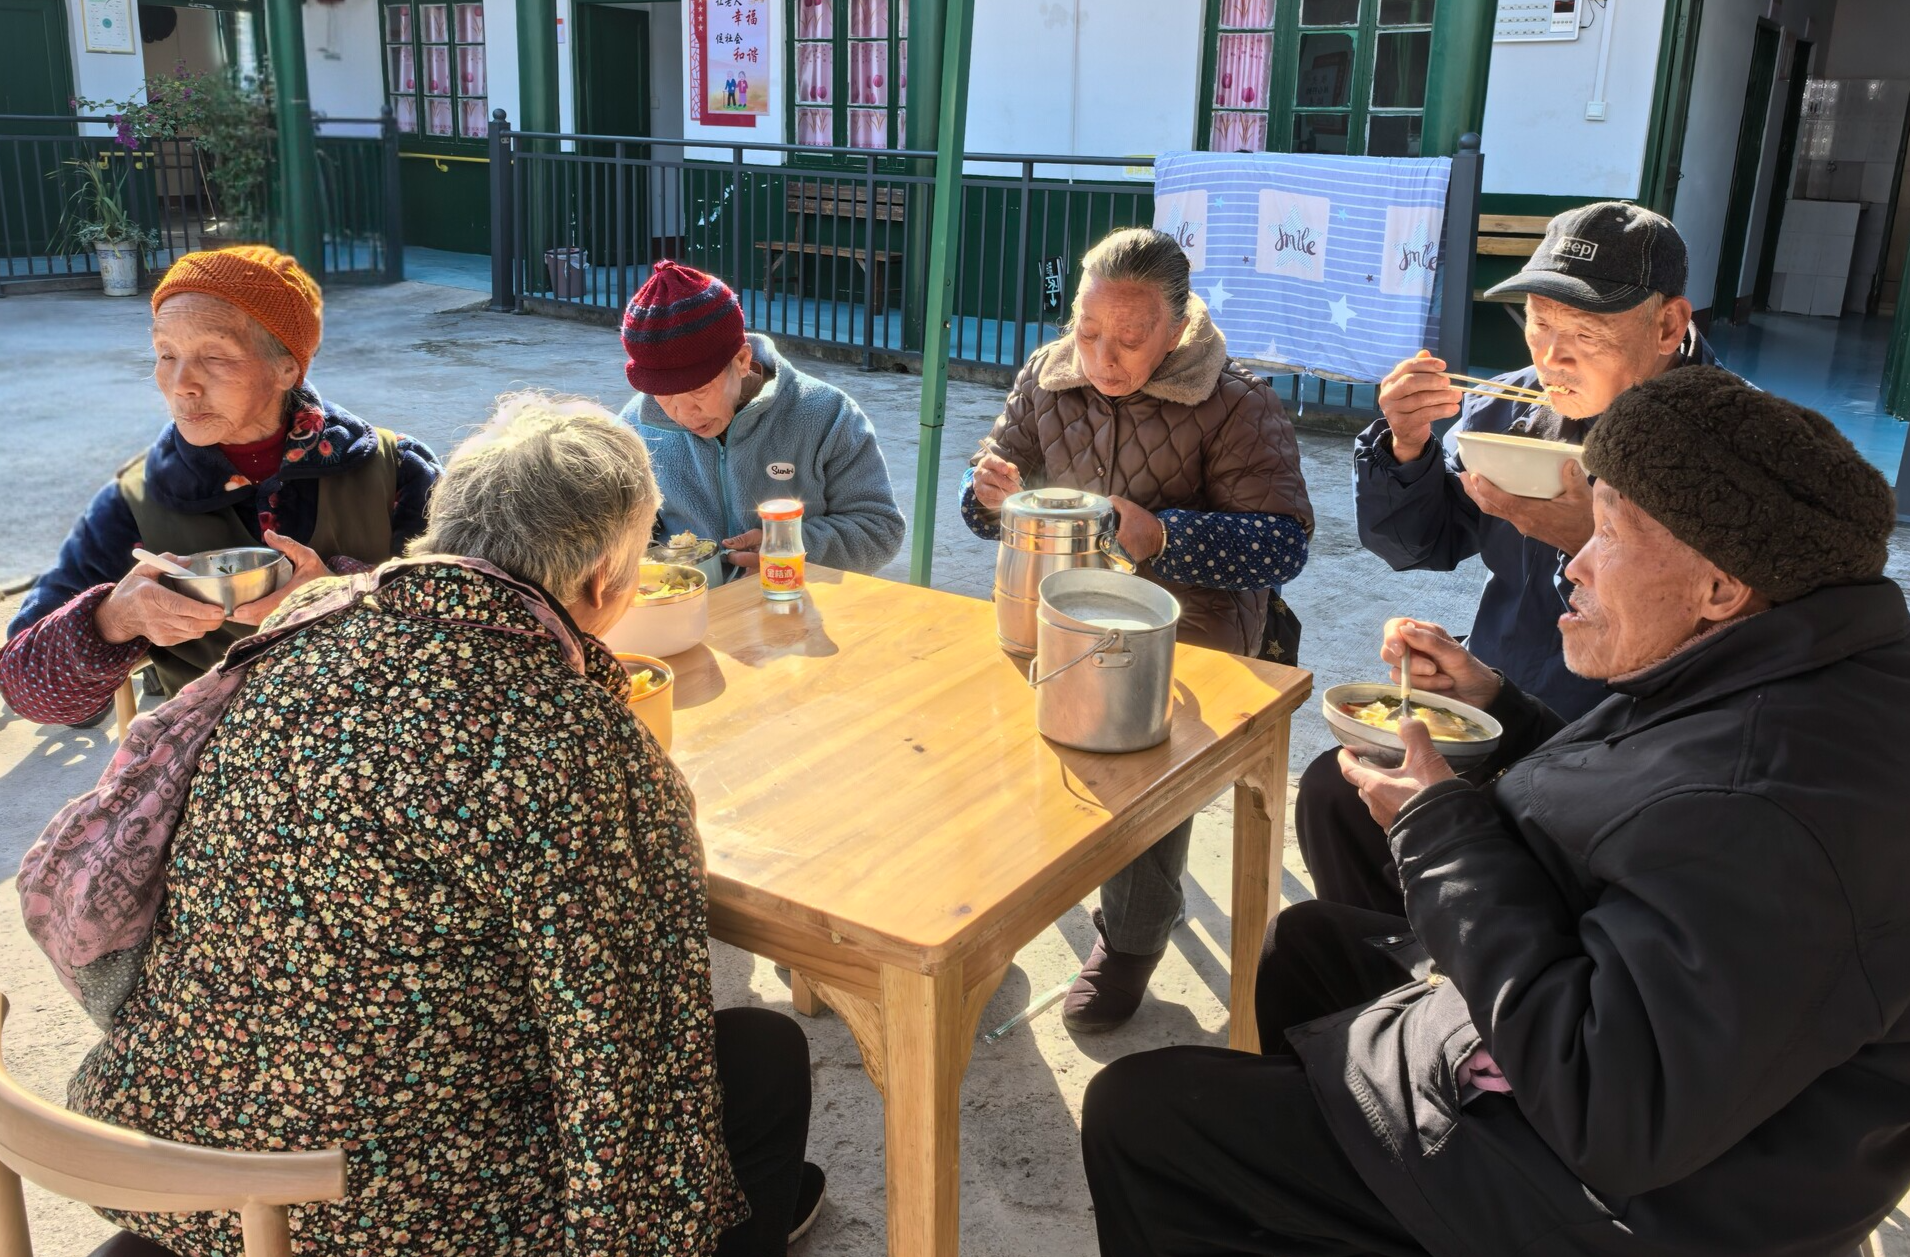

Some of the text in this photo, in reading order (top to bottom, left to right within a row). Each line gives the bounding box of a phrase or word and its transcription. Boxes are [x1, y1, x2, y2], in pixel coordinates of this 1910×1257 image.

[731, 8, 758, 26] 幸福
[715, 32, 743, 45] 促社会
[733, 46, 759, 63] 和谐
[1557, 240, 1592, 257] eep
